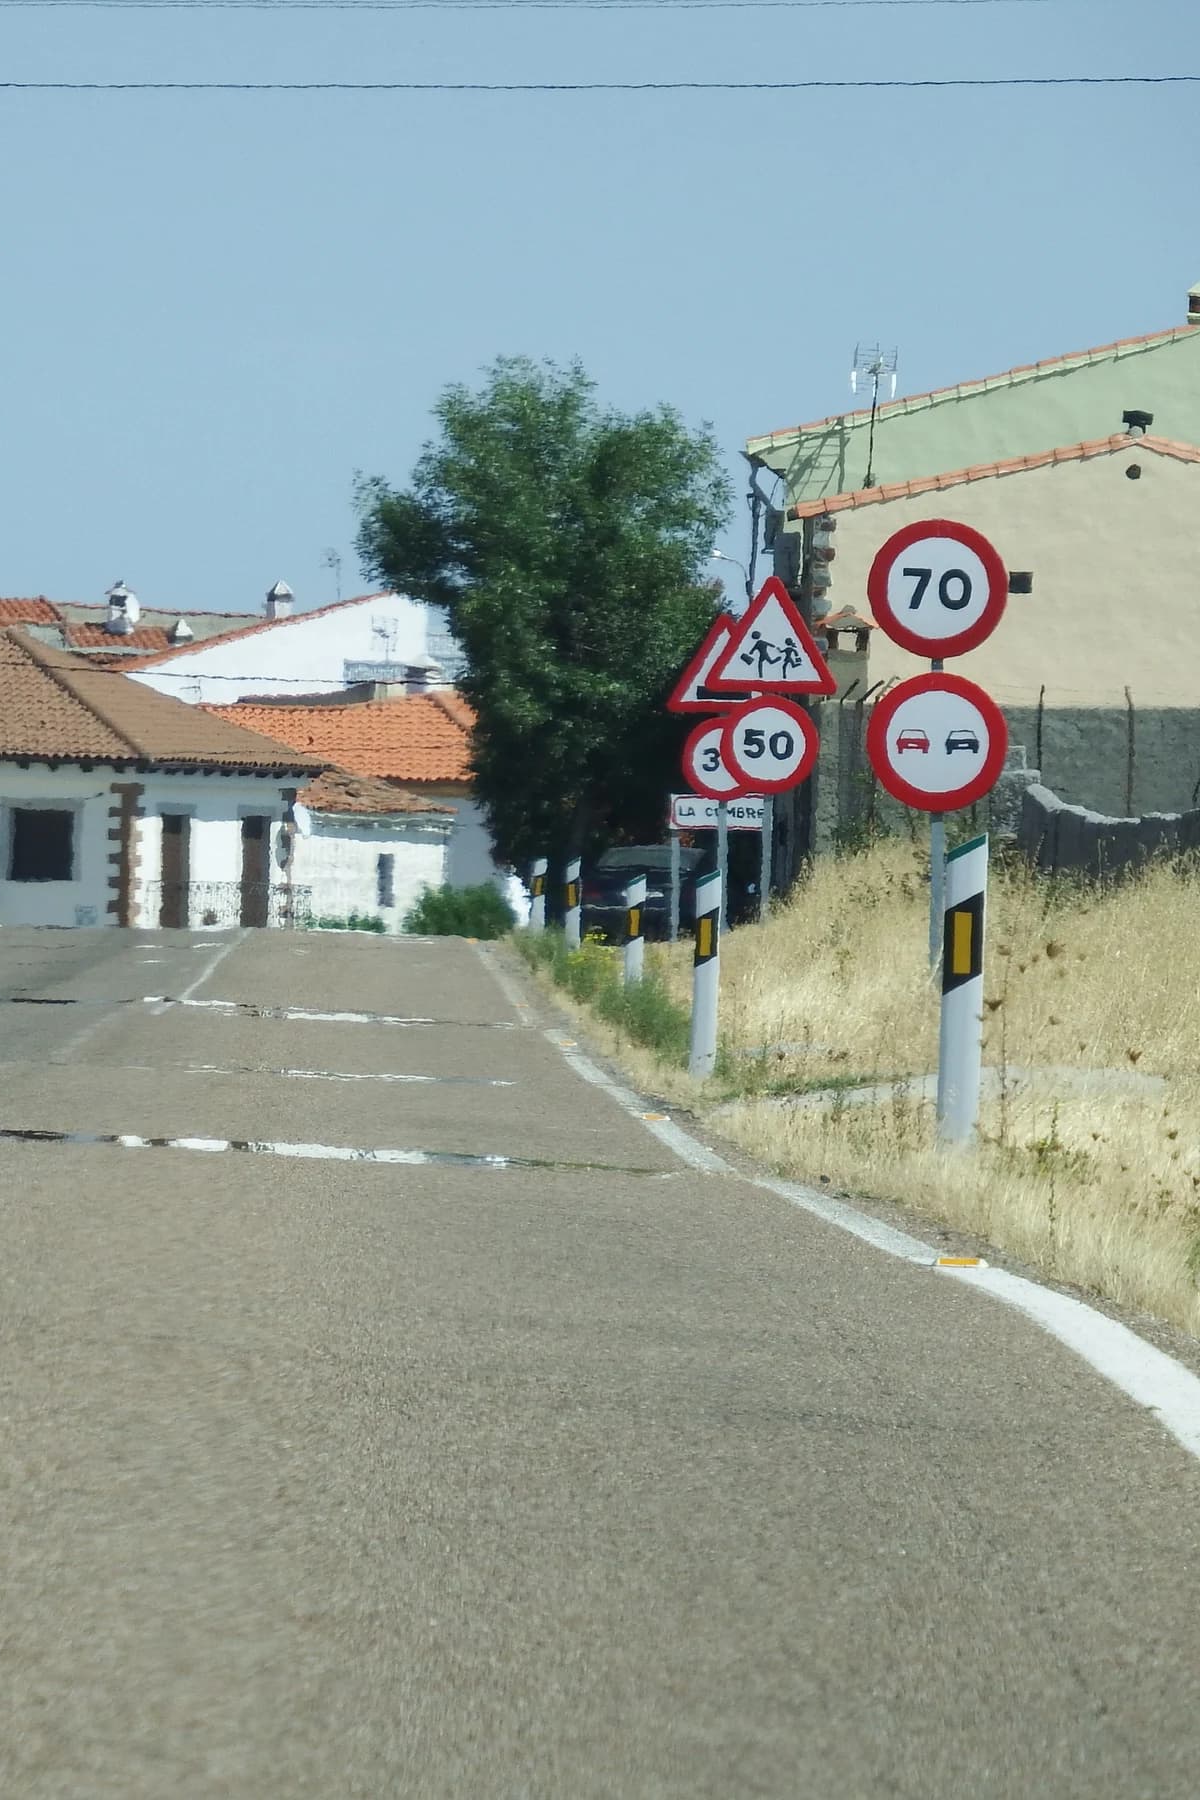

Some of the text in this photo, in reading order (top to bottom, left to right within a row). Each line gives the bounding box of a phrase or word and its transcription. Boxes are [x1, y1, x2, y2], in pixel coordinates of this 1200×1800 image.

[902, 567, 972, 610] 70
[743, 728, 794, 760] 50
[702, 747, 720, 772] 3
[679, 806, 696, 817] LA
